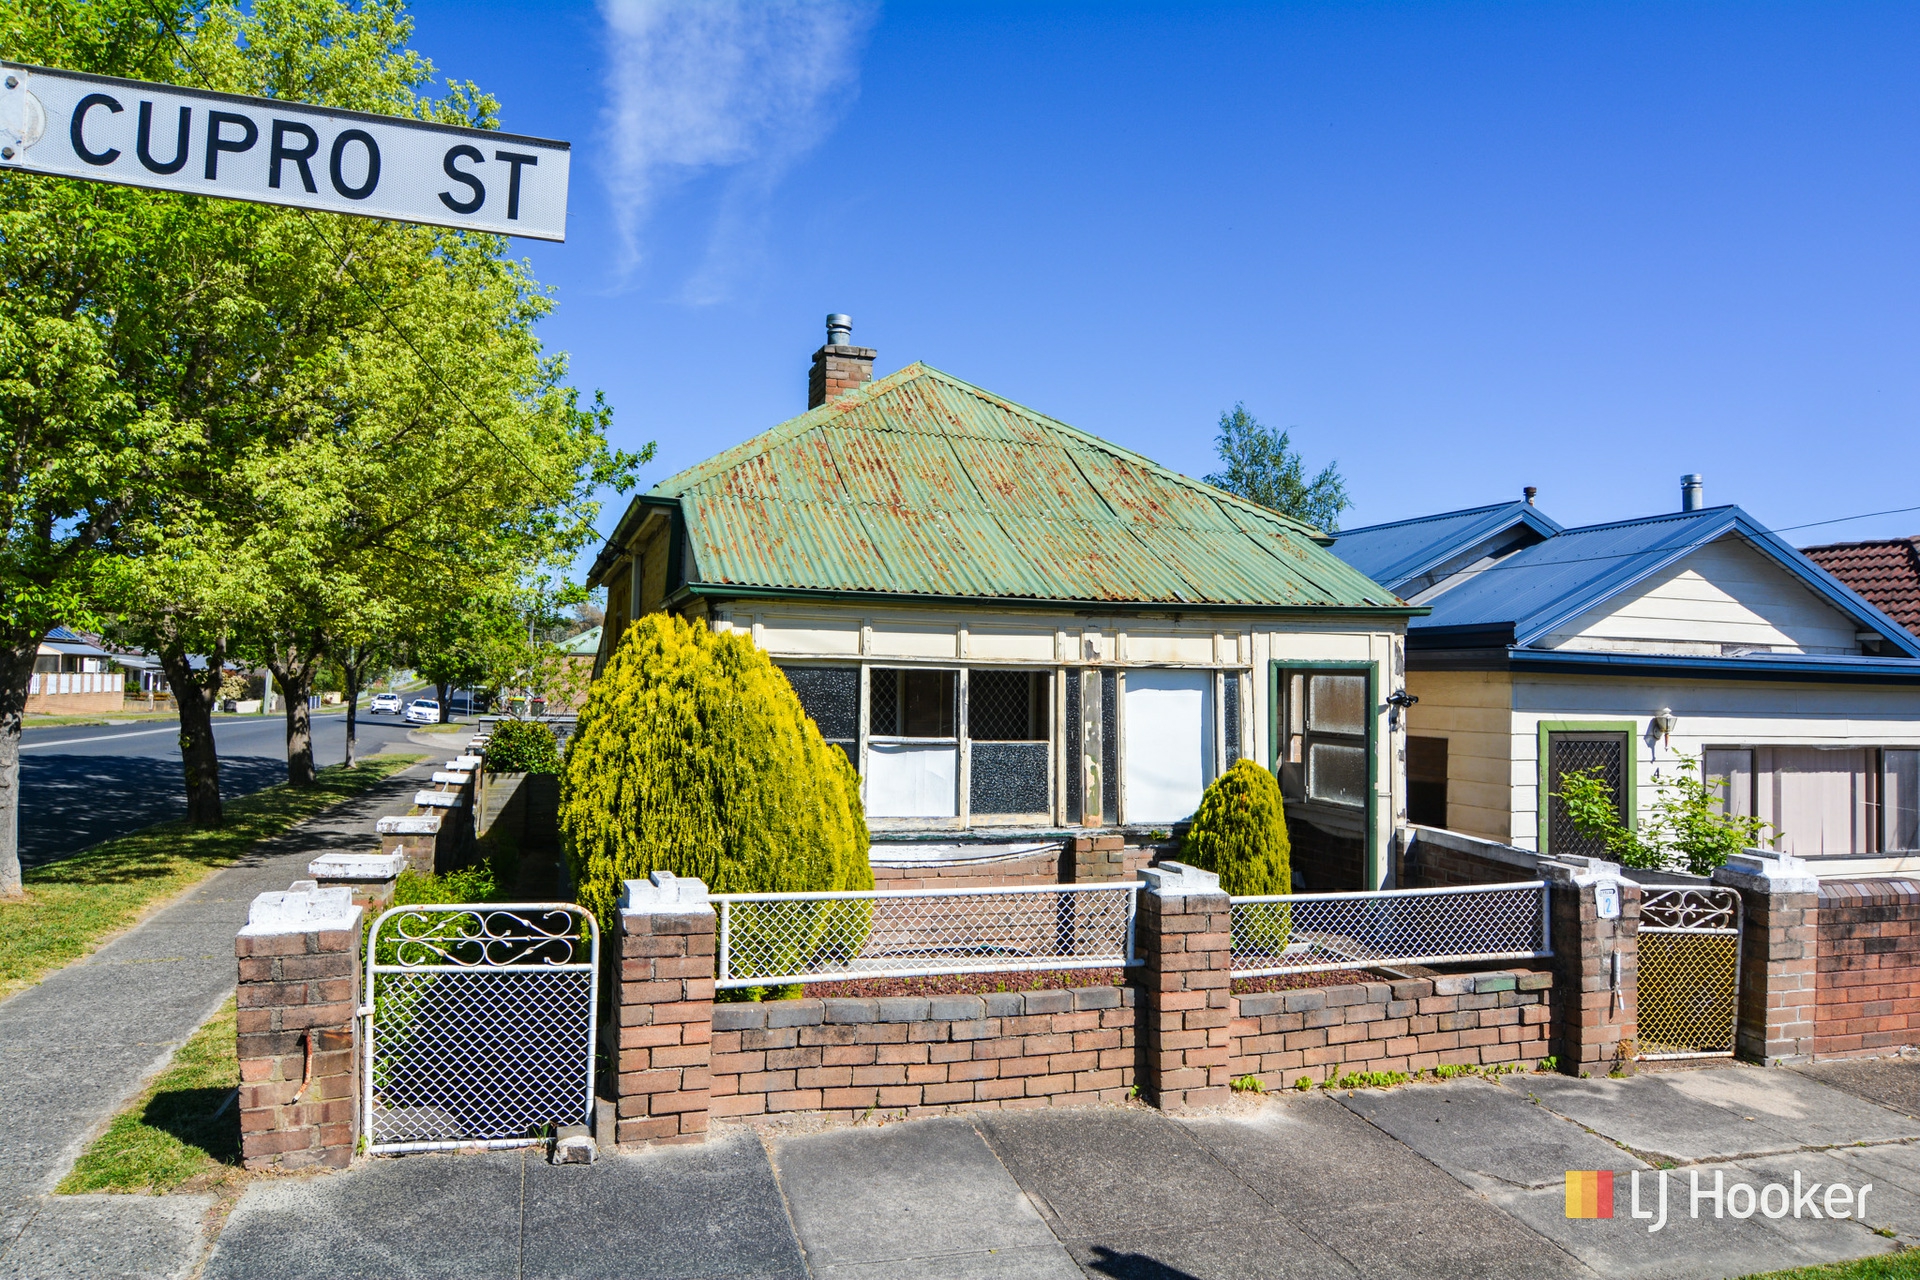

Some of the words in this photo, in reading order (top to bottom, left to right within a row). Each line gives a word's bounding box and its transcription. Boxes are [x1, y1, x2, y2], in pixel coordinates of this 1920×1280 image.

[69, 93, 382, 201] CUPRO
[437, 144, 539, 221] ST
[1653, 766, 1660, 779] 4
[1605, 897, 1612, 913] 2
